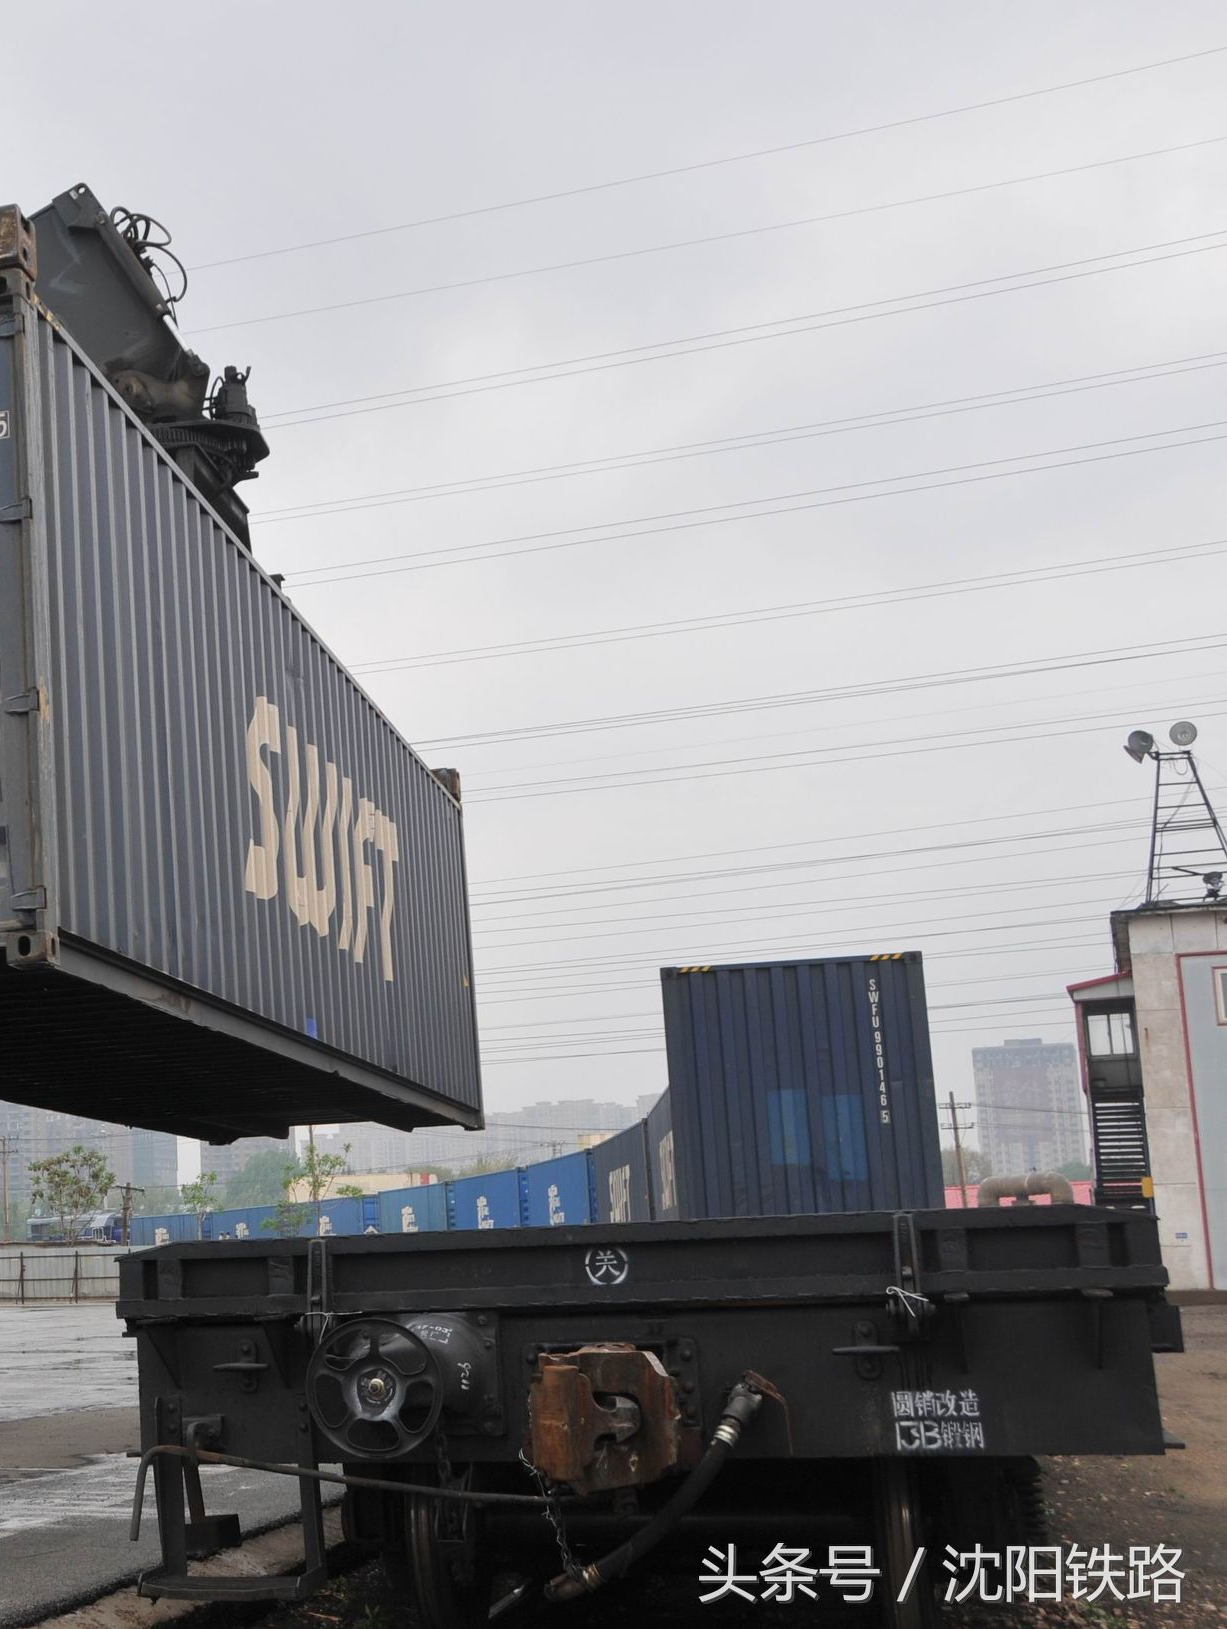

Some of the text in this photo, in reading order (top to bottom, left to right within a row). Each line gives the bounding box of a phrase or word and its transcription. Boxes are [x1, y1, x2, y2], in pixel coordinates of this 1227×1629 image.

[245, 696, 399, 981] SWIFT
[868, 979, 891, 1124] SWFU 990146 5
[891, 1388, 981, 1417] 圆销改造
